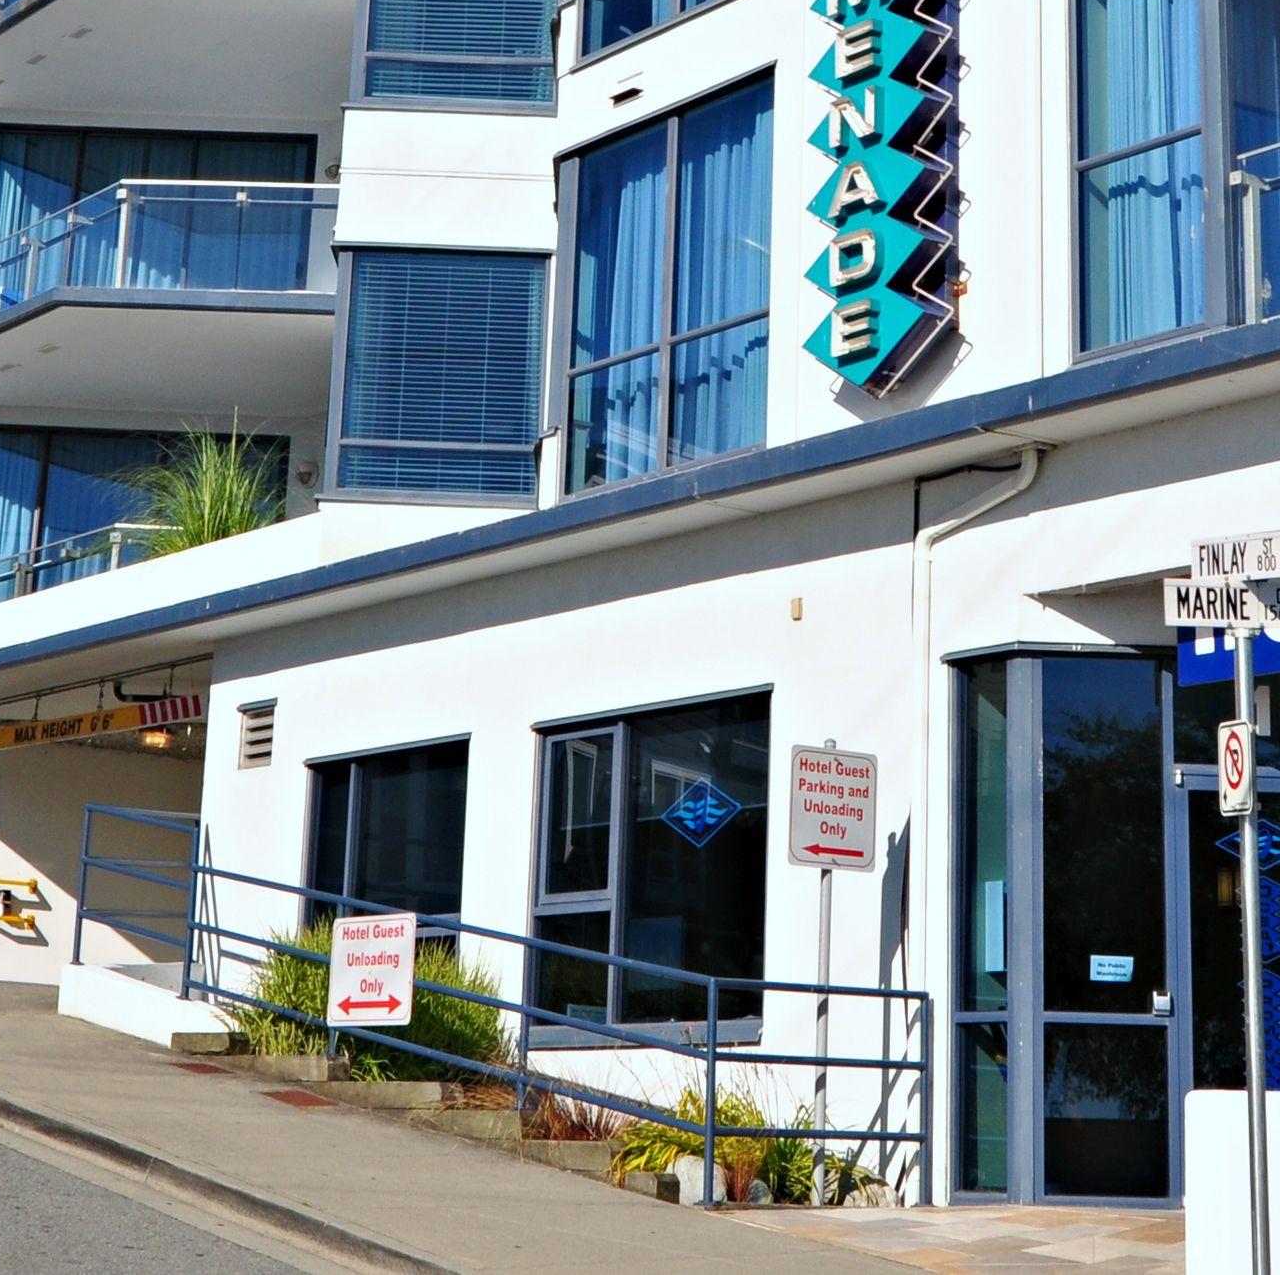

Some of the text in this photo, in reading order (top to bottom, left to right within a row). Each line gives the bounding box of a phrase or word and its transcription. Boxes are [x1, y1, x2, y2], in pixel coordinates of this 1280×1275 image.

[1198, 538, 1273, 577] FINLAY ST
[1257, 554, 1277, 572] 800
[1176, 586, 1251, 621] MARINE
[14, 725, 37, 743] MAX
[41, 718, 83, 739] HEIGHT
[799, 757, 870, 780] Hotel Guest
[798, 778, 869, 799] Parking and
[803, 799, 863, 821] Unloading
[820, 821, 847, 840] Only
[342, 924, 404, 940] Hotel Guest
[347, 952, 400, 968] Unloading
[360, 978, 384, 996] Only
